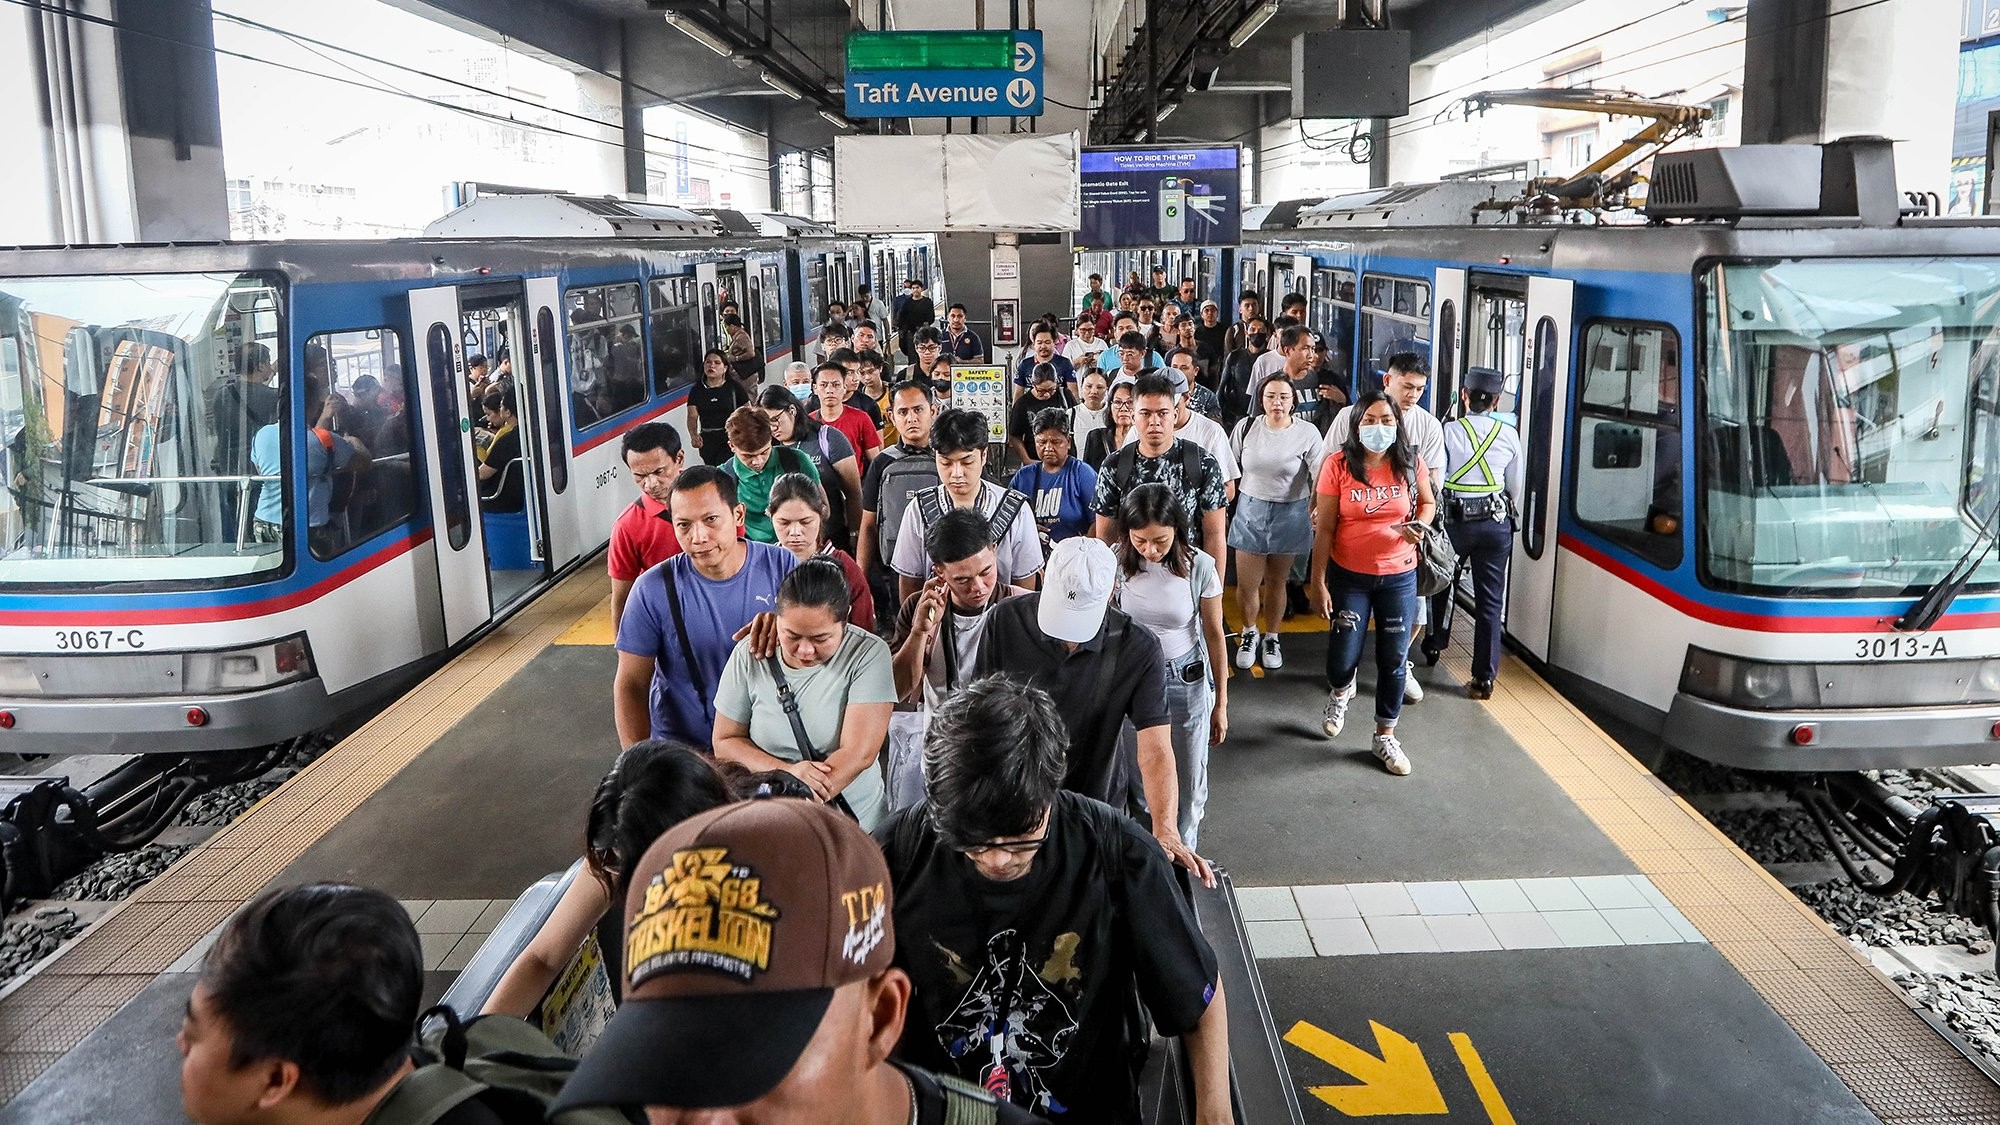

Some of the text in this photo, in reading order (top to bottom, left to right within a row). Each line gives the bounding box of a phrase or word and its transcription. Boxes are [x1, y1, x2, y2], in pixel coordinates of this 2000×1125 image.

[853, 82, 998, 103] Taft Avenue
[1144, 154, 1162, 162] RIDE
[1177, 153, 1196, 161] MRT3
[596, 466, 618, 489] 3067-C
[1350, 485, 1402, 502] NIKE
[55, 629, 145, 650] 3067-C
[1855, 636, 1948, 658] 3013-A
[719, 879, 760, 909] 68
[627, 904, 773, 976] TRISKELION
